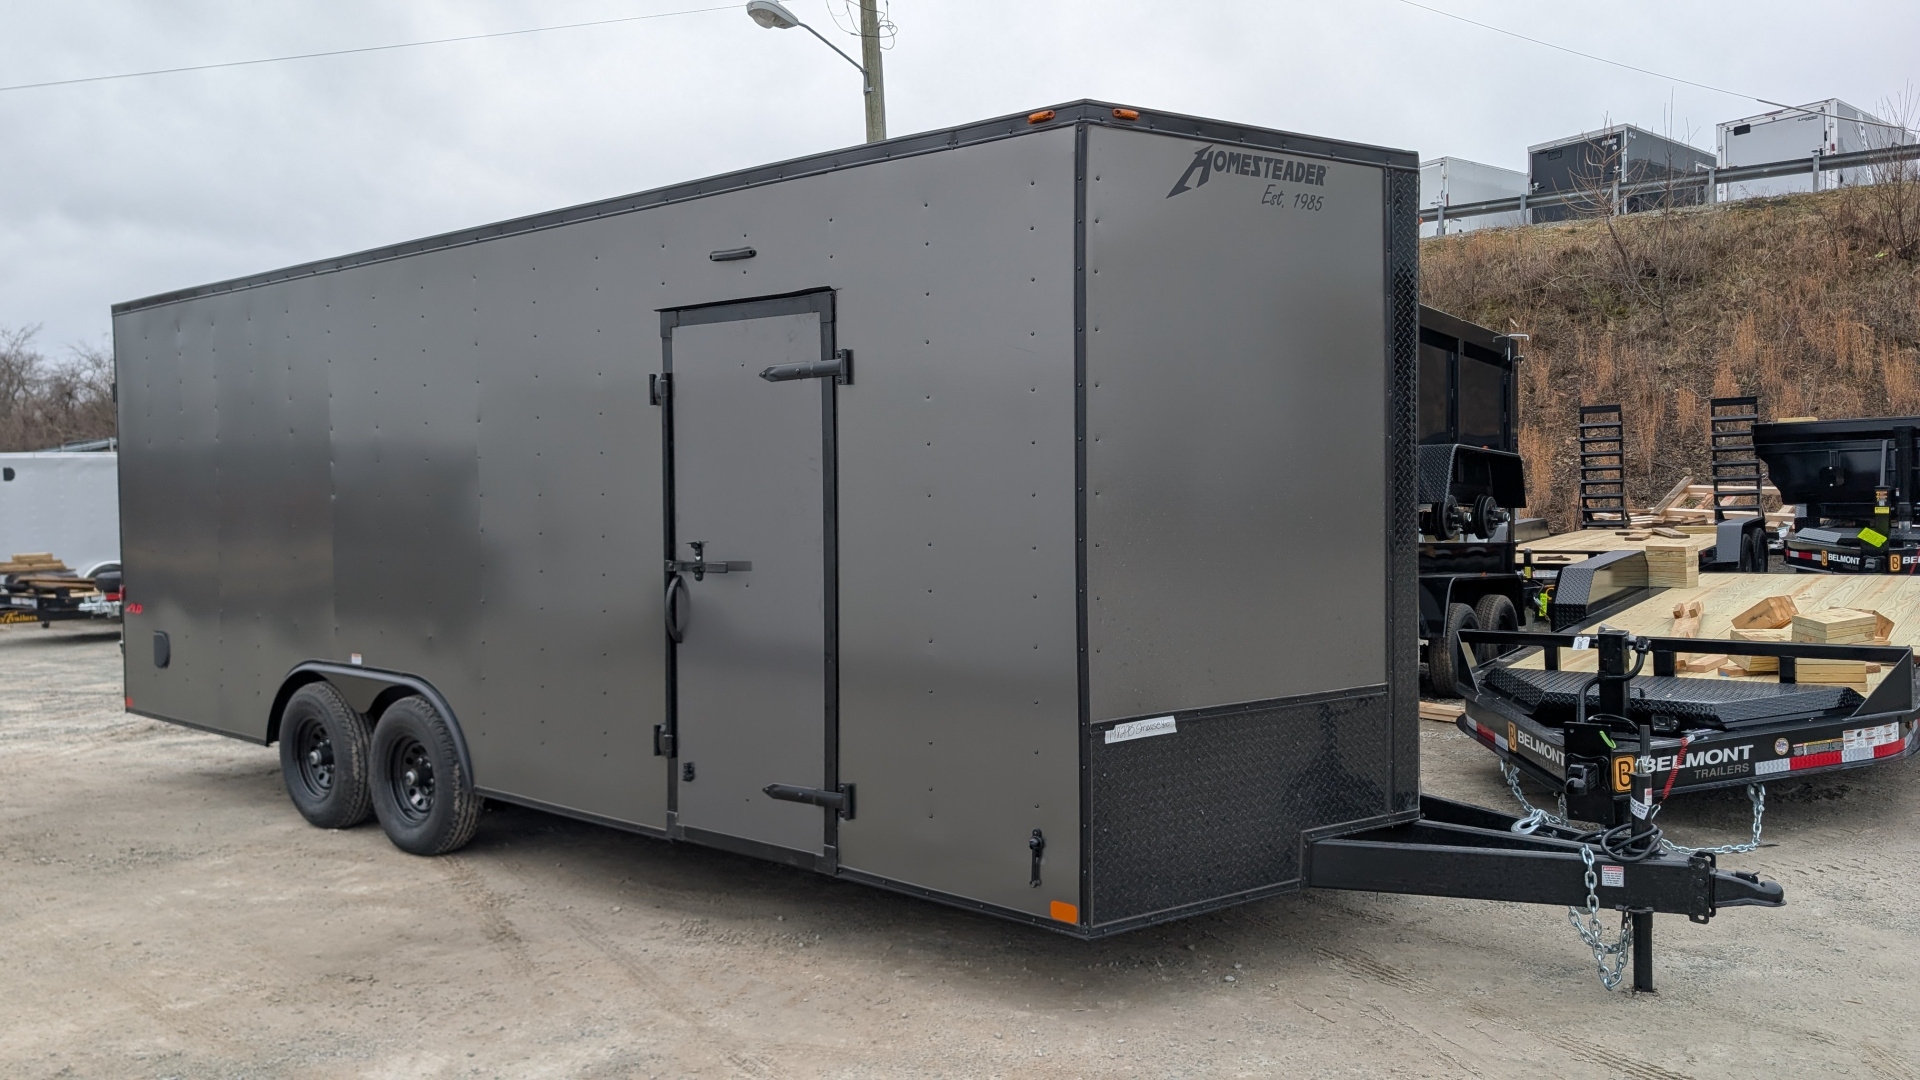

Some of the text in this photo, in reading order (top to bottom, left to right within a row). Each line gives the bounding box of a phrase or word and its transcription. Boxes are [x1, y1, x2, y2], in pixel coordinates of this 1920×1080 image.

[1166, 144, 1328, 199] HOMESTEADER
[1293, 193, 1325, 212] 1985
[1828, 553, 1861, 566] BELMONT
[1517, 729, 1566, 767] BELMONT
[1645, 744, 1754, 773] BELMONT
[1693, 763, 1750, 780] TRAILERS
